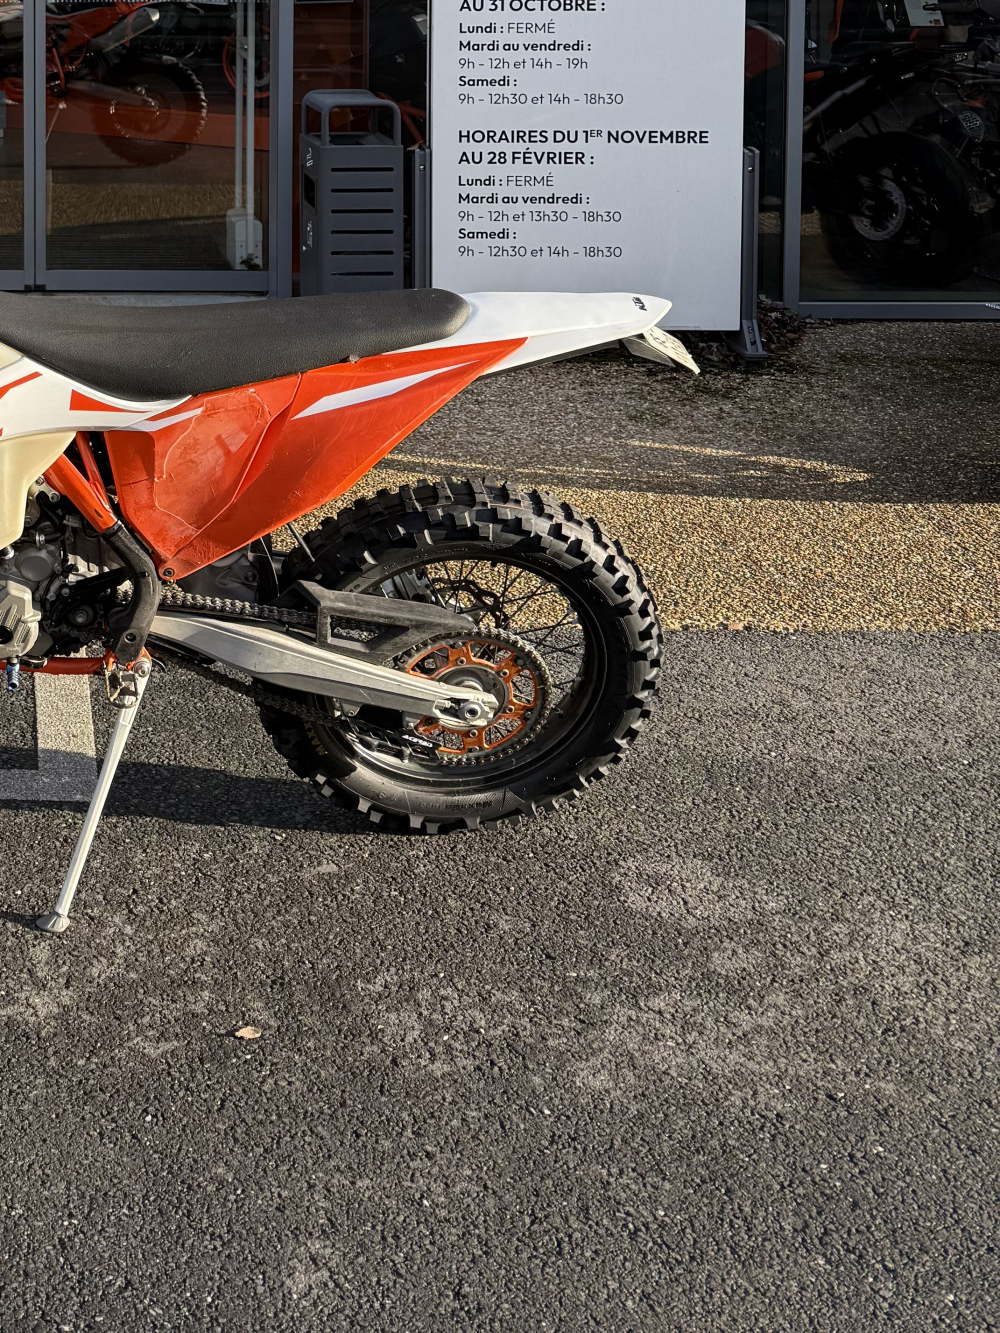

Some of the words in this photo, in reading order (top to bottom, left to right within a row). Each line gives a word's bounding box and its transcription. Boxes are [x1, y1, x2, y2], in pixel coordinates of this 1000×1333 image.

[460, 0, 484, 11] AU
[489, 0, 504, 11] 31
[460, 23, 496, 33] Lundi
[508, 19, 555, 33] FERMÉ
[460, 40, 499, 51] Mardi
[523, 40, 583, 51] vendredi
[459, 58, 474, 69] 9h
[489, 58, 509, 69] 12h
[514, 59, 526, 69] et
[530, 58, 552, 69] 14h
[566, 58, 587, 69] 19h
[459, 76, 509, 86] Samedi
[459, 94, 474, 104] 9h
[489, 94, 527, 104] 12h30
[531, 94, 544, 104] et
[548, 94, 569, 104] 14h
[584, 94, 623, 104] 18h30
[459, 130, 548, 143] HORAIRES
[554, 130, 578, 143] DU
[583, 130, 602, 143] 1ER
[608, 130, 708, 143] NOVEMBRE
[458, 152, 482, 164] AU
[488, 152, 507, 164] 28
[512, 147, 585, 164] FÉVRIER
[459, 176, 495, 186] Lundi
[507, 172, 553, 186] FERMÉ
[459, 193, 498, 204] Mardi
[522, 193, 582, 204] vendredi
[458, 211, 474, 221] 9h
[488, 211, 508, 221] 12h
[513, 212, 525, 221] et
[529, 211, 568, 222] 13h30
[583, 211, 621, 222] 18h30
[459, 228, 509, 239] Samedi
[458, 246, 474, 256] 9h
[488, 246, 526, 257] 12h30
[531, 247, 543, 257] et
[548, 246, 569, 257] 14h
[583, 247, 622, 257] 18h30
